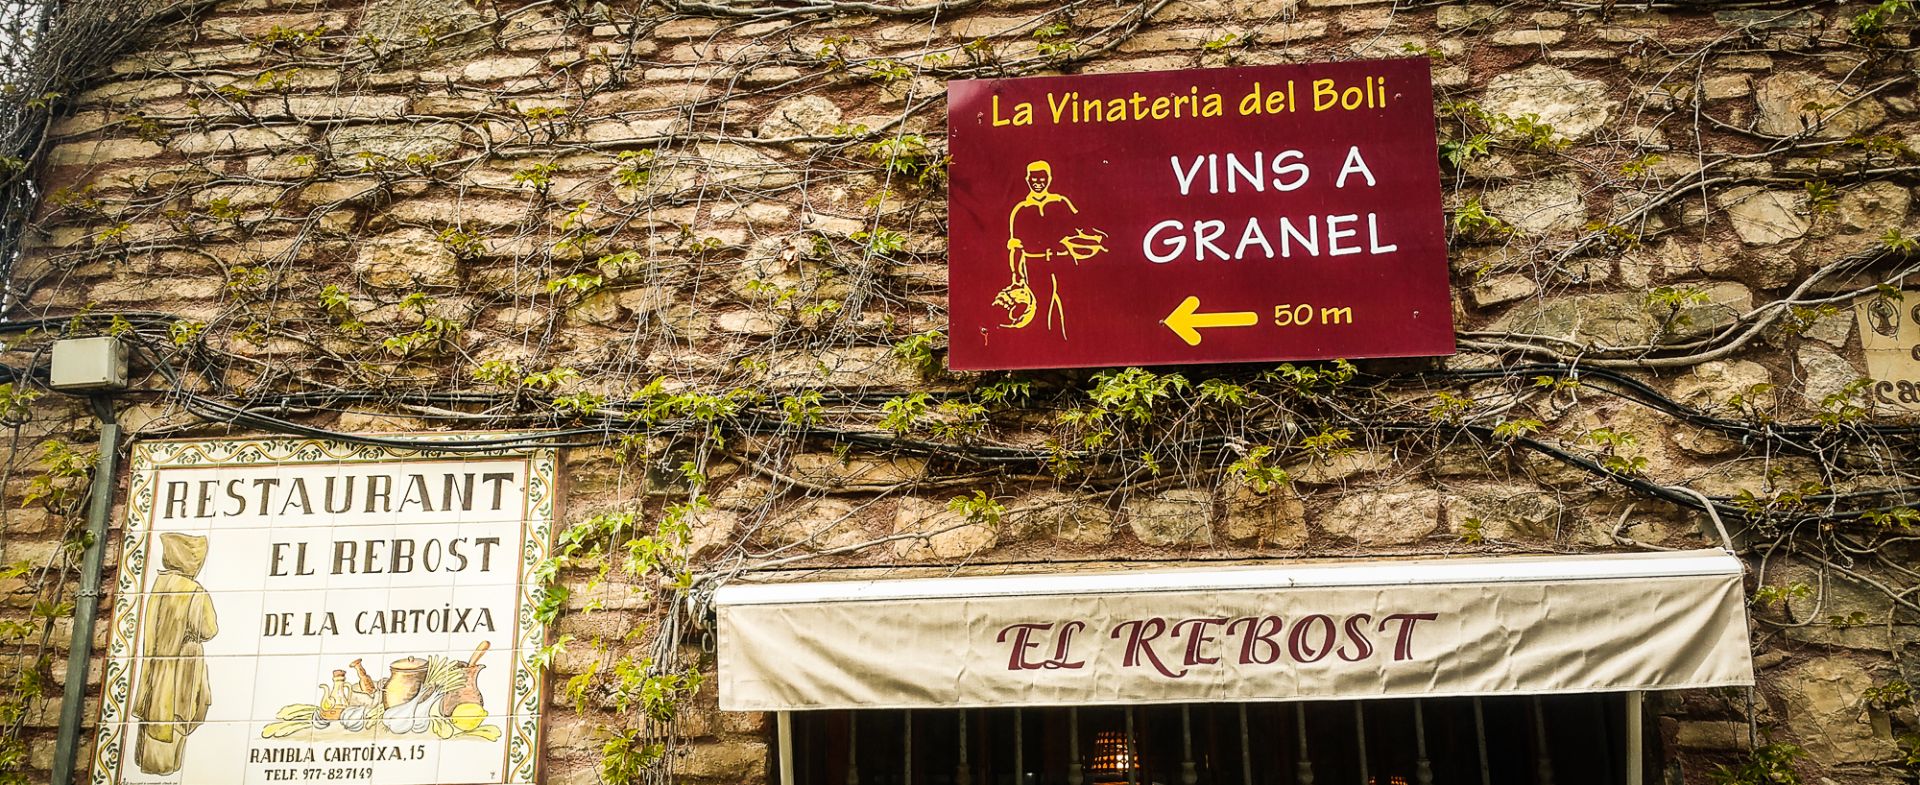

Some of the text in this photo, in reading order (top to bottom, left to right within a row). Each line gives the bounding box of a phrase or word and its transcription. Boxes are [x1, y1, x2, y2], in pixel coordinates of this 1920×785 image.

[992, 76, 1386, 127] La Vinateria del Boli
[1170, 145, 1376, 196] VINS A
[1142, 212, 1398, 264] GRANEL
[1274, 303, 1353, 327] 50 m
[163, 472, 515, 519] RESTAURANT
[269, 537, 500, 577] EL REBOST
[263, 612, 294, 637] DE
[302, 611, 339, 636] LA
[996, 613, 1438, 678] EL REBOST
[249, 747, 316, 764] RAMBLA
